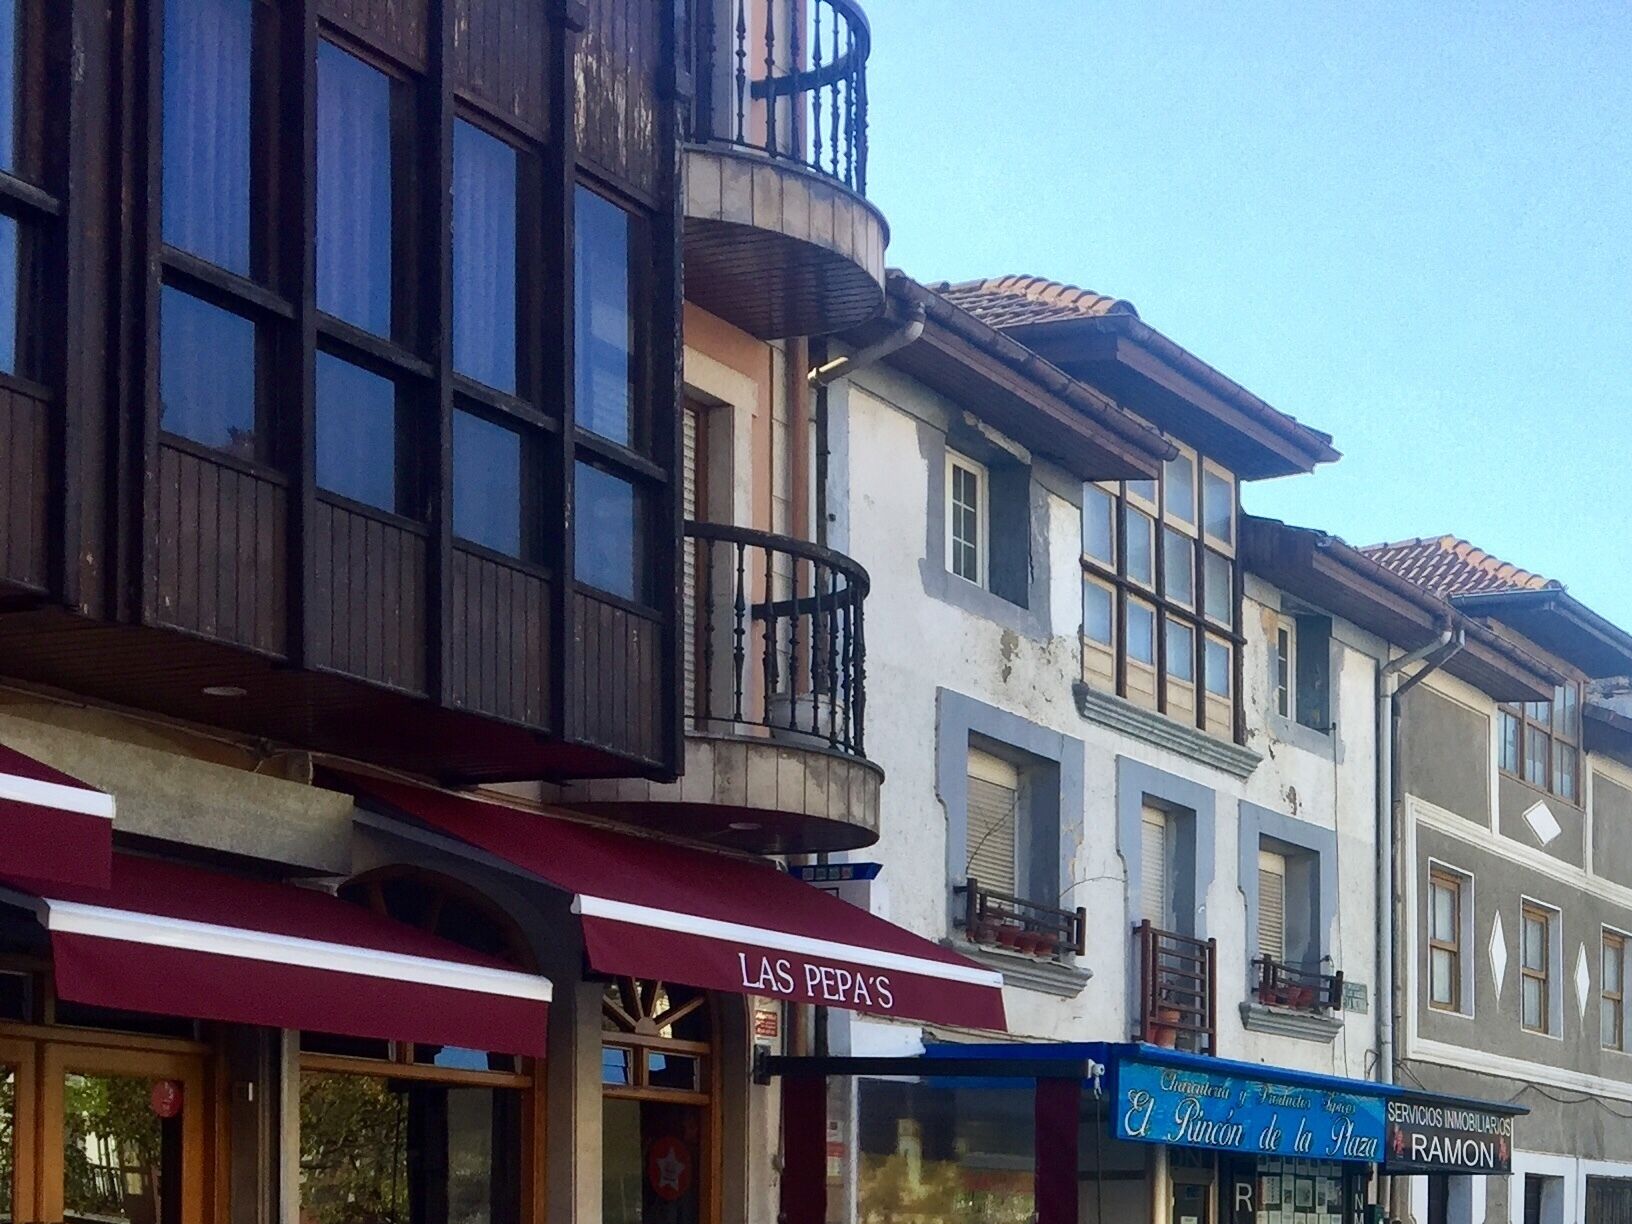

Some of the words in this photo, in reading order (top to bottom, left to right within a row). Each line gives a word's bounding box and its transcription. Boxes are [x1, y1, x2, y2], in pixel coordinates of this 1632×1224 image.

[738, 952, 794, 993] LAS
[1124, 1089, 1154, 1137] El
[1168, 1097, 1243, 1147] Rincón
[1259, 1114, 1281, 1151] de
[1294, 1117, 1311, 1153] la
[1325, 1116, 1378, 1158] Plaza
[1387, 1101, 1443, 1129] SERVICIOS
[1444, 1107, 1511, 1137] INMOBILIARIOS
[1411, 1133, 1494, 1169] RAMON
